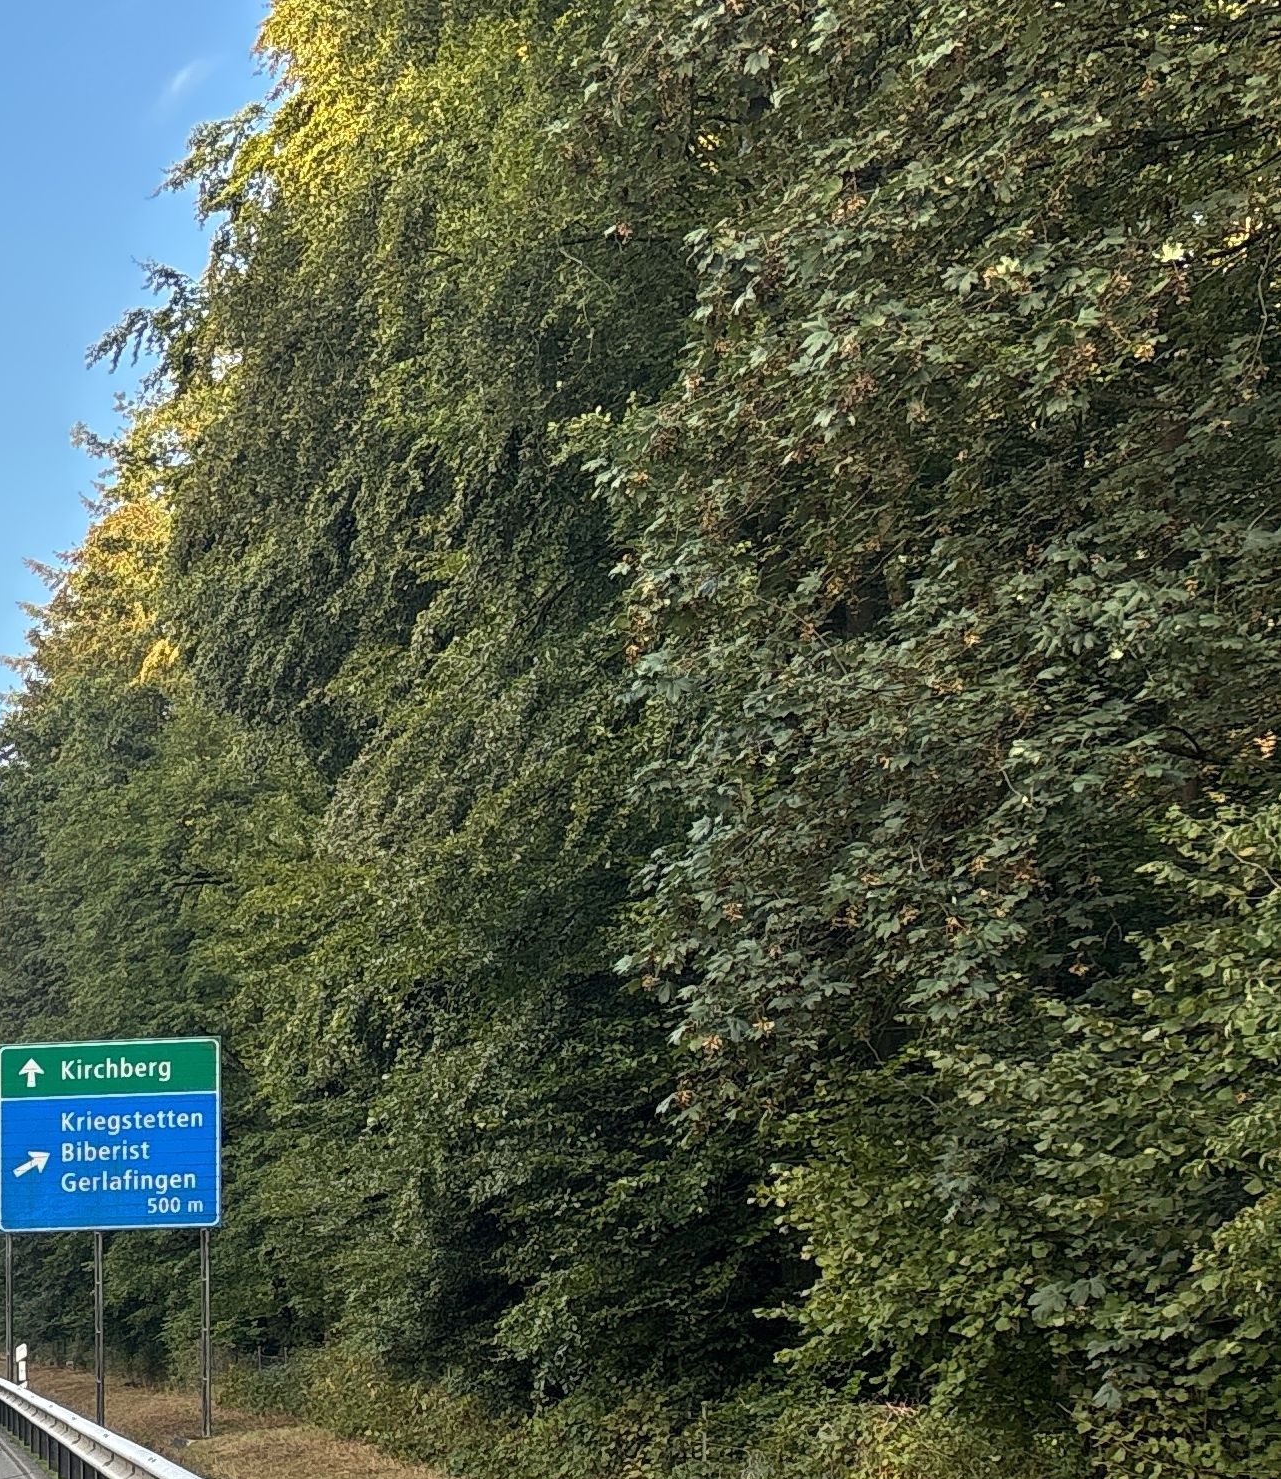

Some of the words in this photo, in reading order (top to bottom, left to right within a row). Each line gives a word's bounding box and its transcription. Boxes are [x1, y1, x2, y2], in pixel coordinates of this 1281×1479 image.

[61, 1056, 171, 1081] Kirchberg
[61, 1111, 203, 1135] Kriegstetten
[61, 1141, 150, 1162] Biberist
[61, 1170, 196, 1194] Gerlafingen
[147, 1197, 181, 1214] 500
[187, 1200, 204, 1213] m
